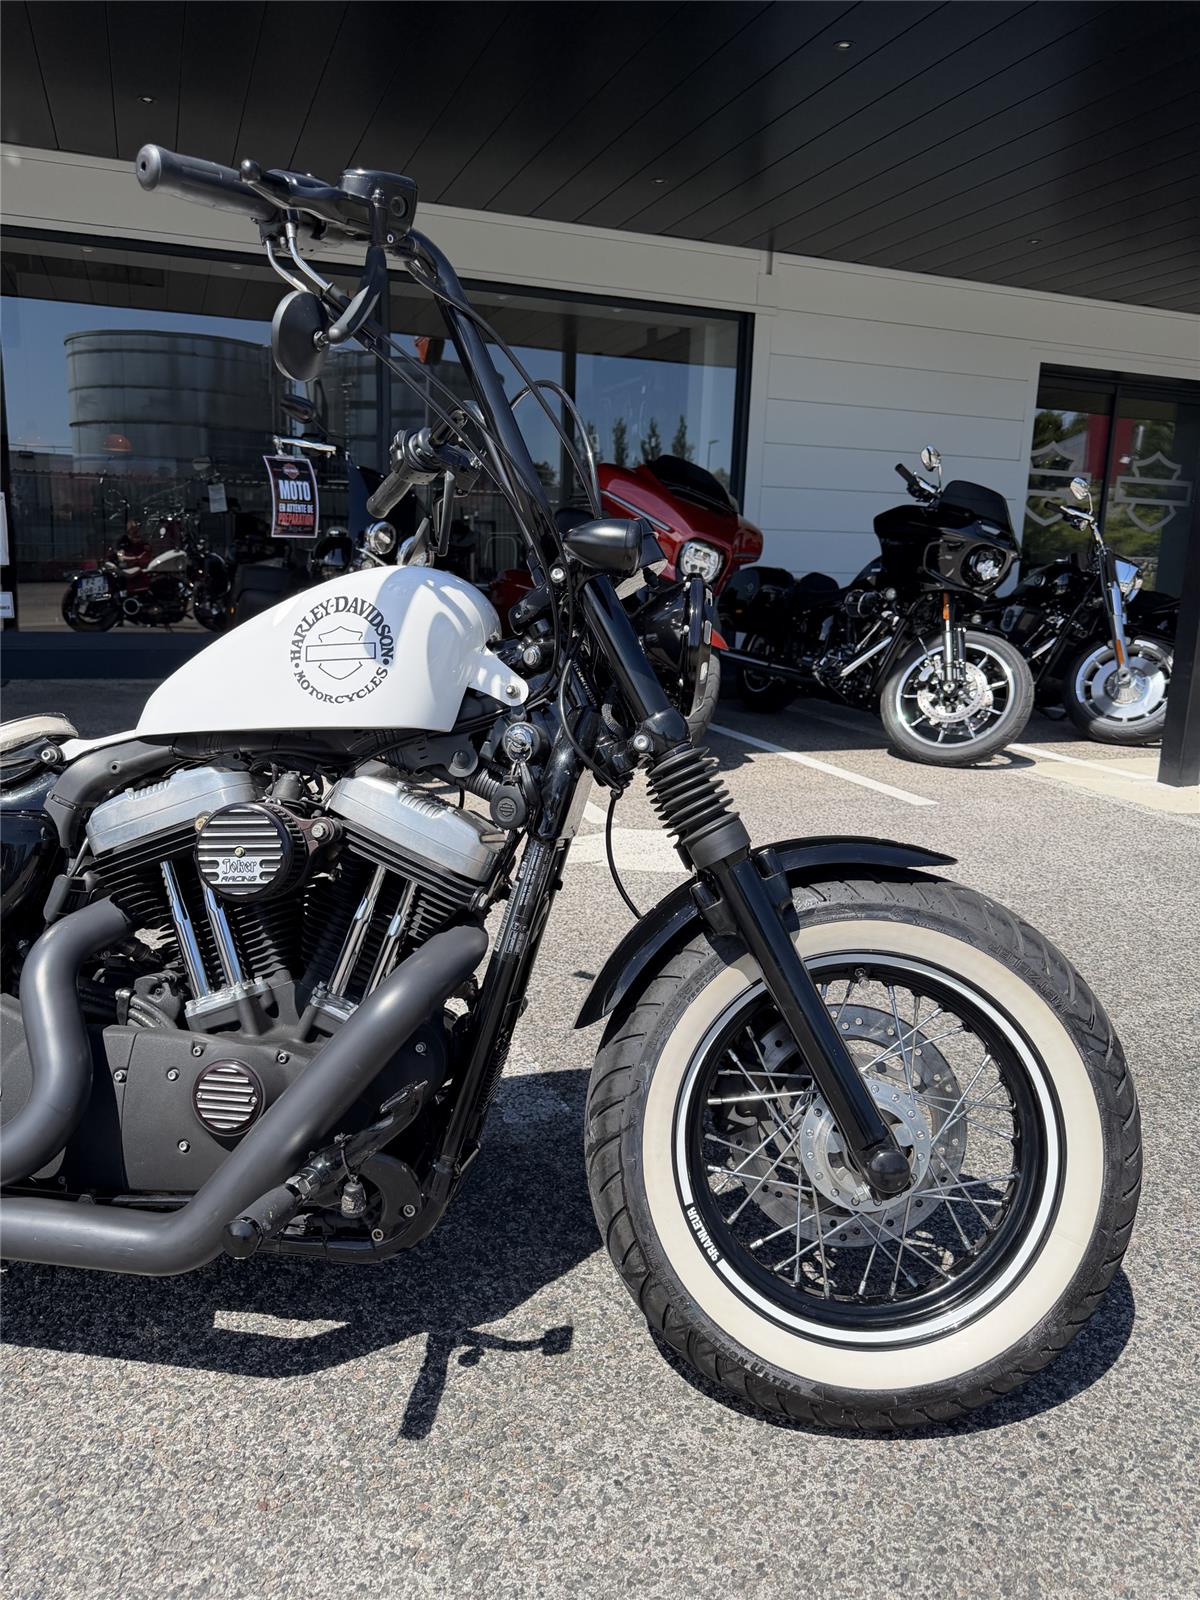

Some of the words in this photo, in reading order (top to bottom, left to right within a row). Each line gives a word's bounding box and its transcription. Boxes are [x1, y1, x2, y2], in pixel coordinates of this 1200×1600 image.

[278, 480, 311, 501] MOTO
[290, 596, 394, 662] HARLEY-DAVIDSON
[294, 667, 388, 704] MOTORCYCLES
[747, 1360, 804, 1393] ULTRA
